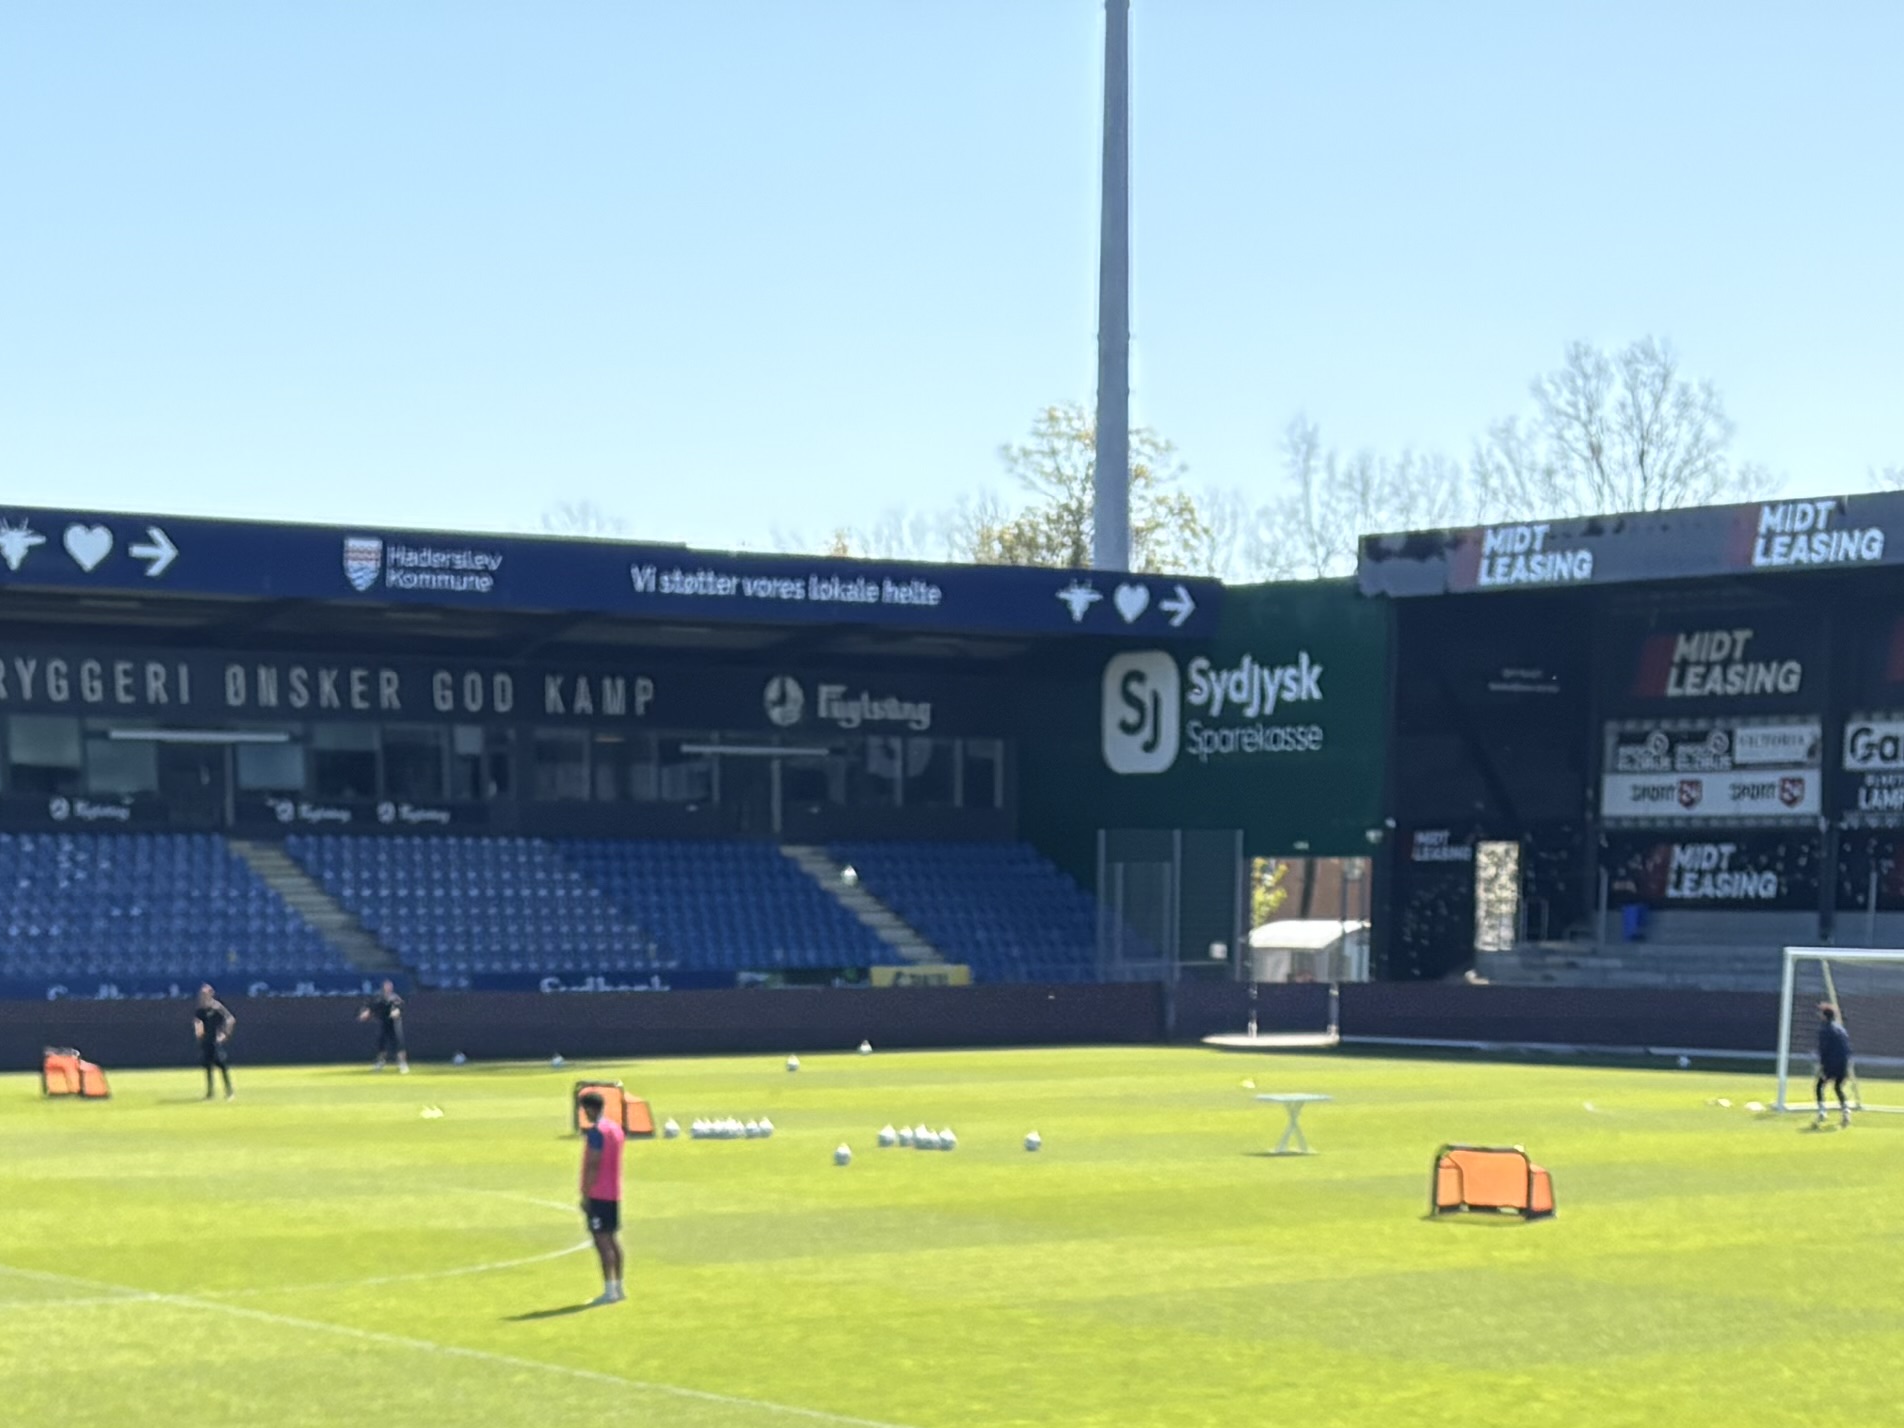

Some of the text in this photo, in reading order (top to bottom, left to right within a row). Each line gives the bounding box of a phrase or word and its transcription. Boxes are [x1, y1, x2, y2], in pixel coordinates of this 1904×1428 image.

[1759, 501, 1836, 534] MIDT
[1483, 525, 1549, 556] MIDT
[1752, 527, 1884, 567] LEASING
[387, 567, 493, 591] Kommune
[631, 564, 655, 594] Vi
[742, 574, 805, 600] vores
[1477, 551, 1592, 585] LEASING
[1673, 630, 1753, 660] MIDT
[225, 662, 401, 709] ØNSKER
[432, 671, 514, 712] GOD
[545, 675, 655, 716] KAMP
[1187, 652, 1323, 716] Sydjysk
[1666, 660, 1801, 697] LEASING
[1186, 721, 1323, 762] Sparekasse
[1672, 844, 1736, 869] MIDT
[1666, 870, 1778, 898] LEASING
